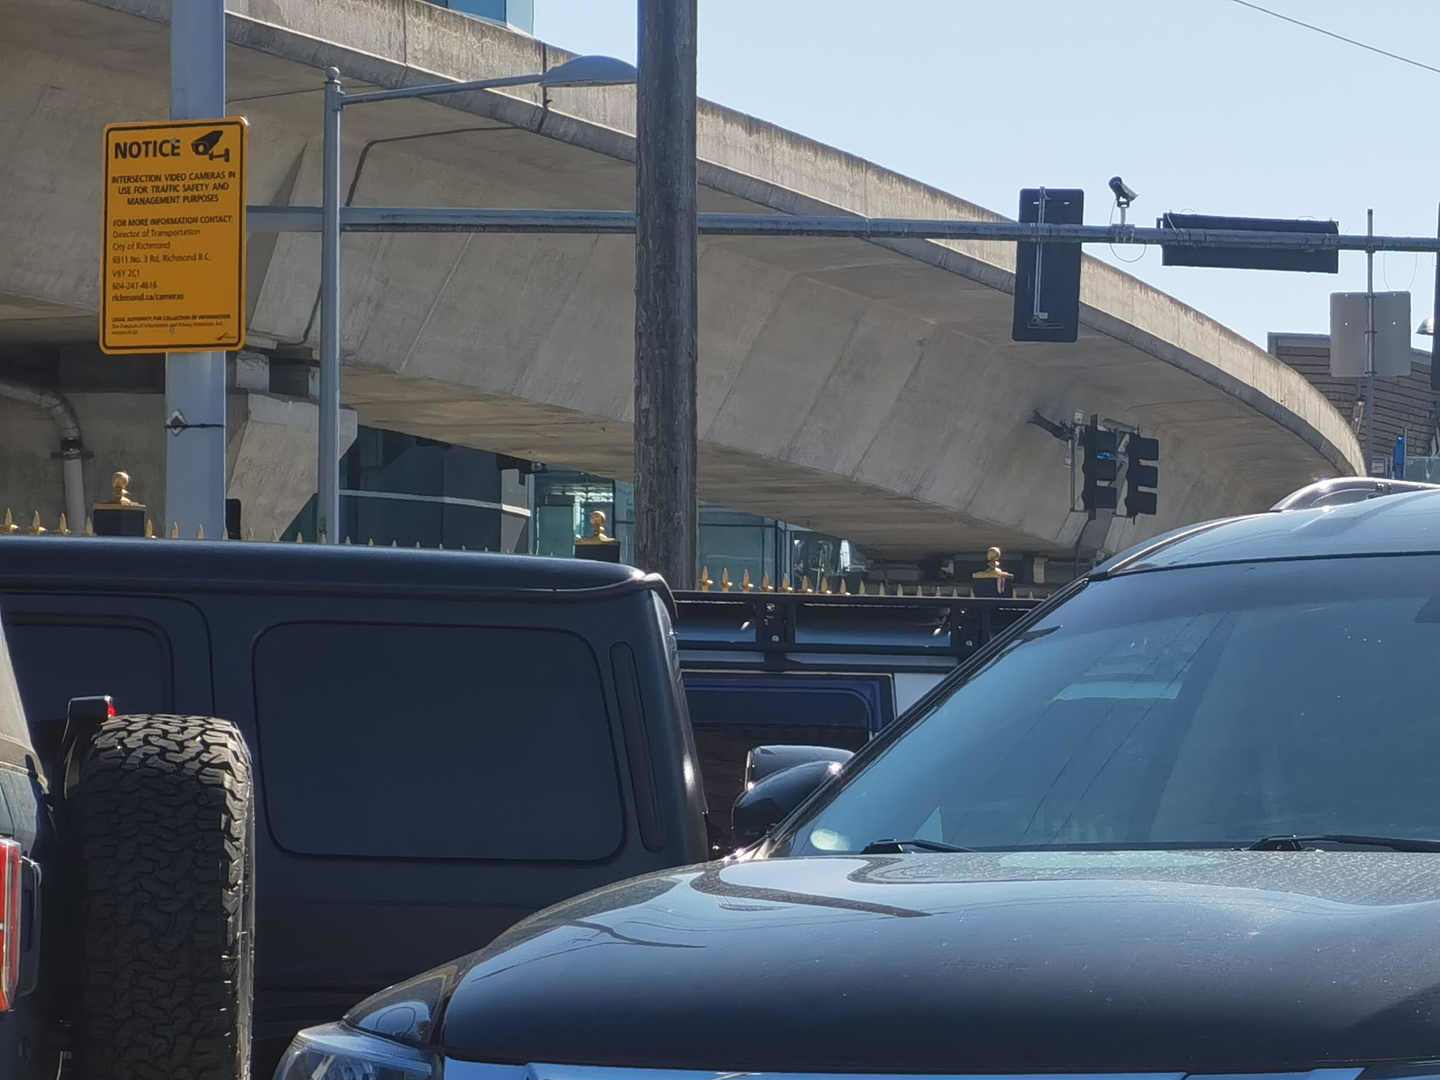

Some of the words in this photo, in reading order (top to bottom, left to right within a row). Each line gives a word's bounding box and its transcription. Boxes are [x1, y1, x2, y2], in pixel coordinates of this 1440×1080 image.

[114, 139, 181, 159] NOTICE
[111, 174, 161, 184] INTERSECTION
[164, 173, 187, 182] VIDEO
[189, 172, 226, 181] CAMERAS
[118, 186, 131, 194] USE
[151, 184, 180, 193] TRAFFIC
[182, 183, 209, 192] SAFETY
[212, 183, 230, 191] AND
[127, 195, 181, 205] MANAGEMENT
[183, 194, 219, 203] PURPOSES
[113, 219, 127, 227] FOR
[128, 218, 148, 226] MORE
[150, 216, 198, 225] INFORMATION
[200, 215, 232, 223] CONTACT
[141, 228, 149, 236] of
